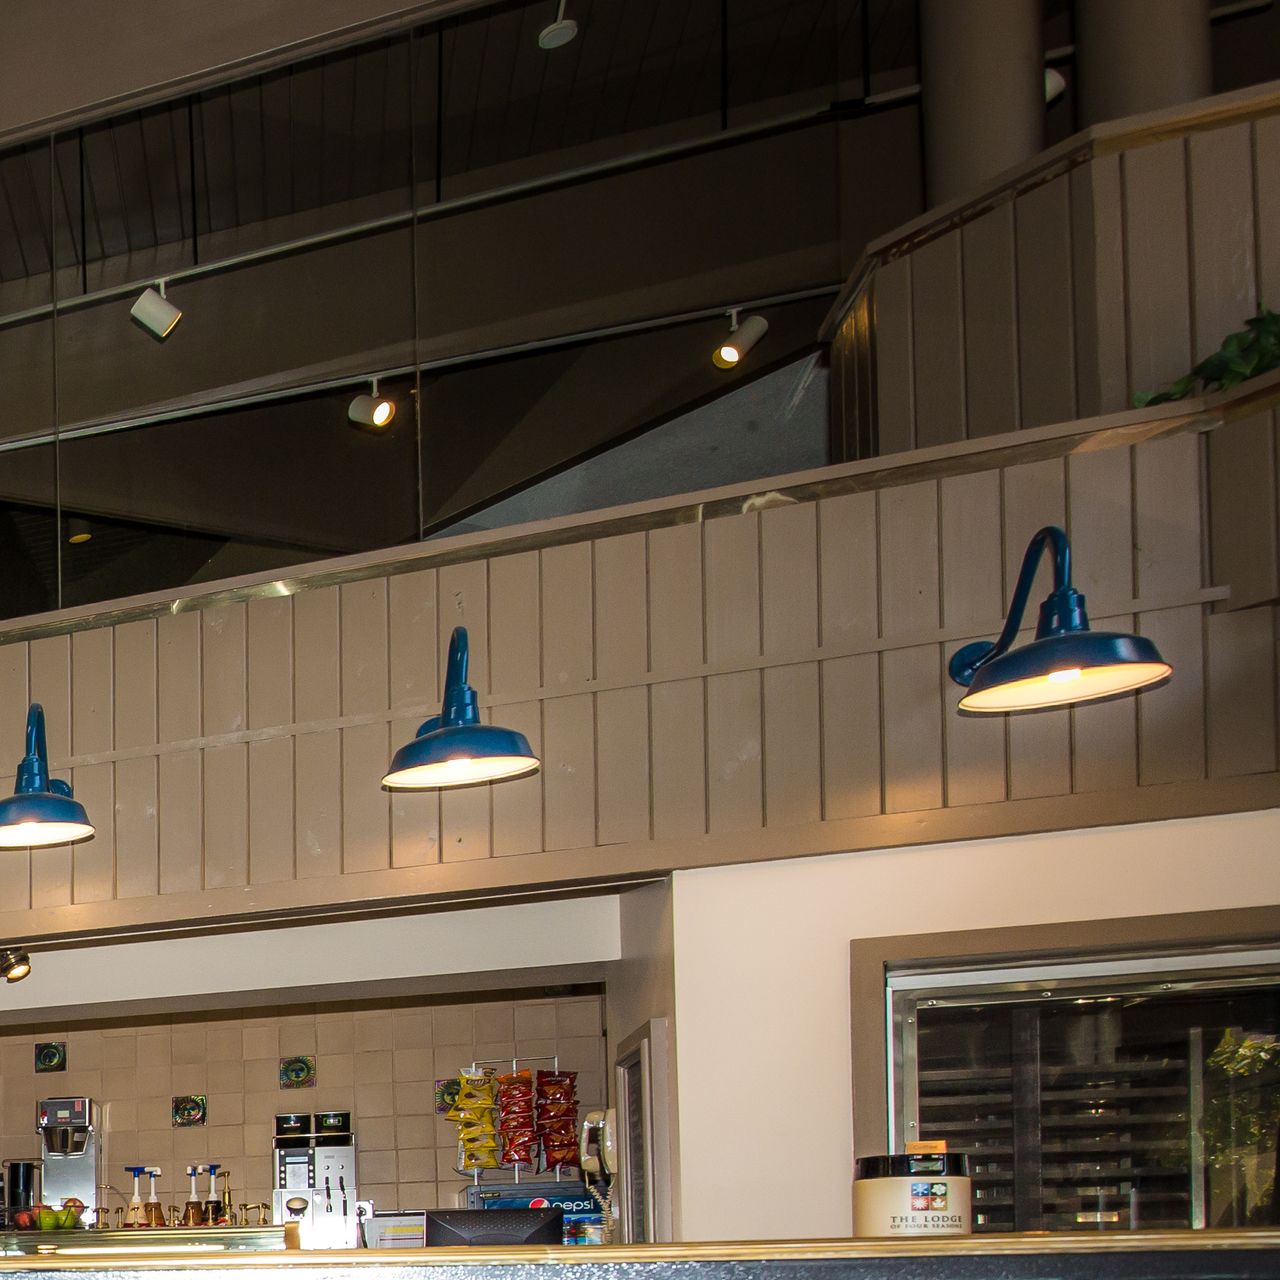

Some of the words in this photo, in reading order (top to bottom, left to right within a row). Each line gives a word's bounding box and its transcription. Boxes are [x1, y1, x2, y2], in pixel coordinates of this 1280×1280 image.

[552, 1199, 594, 1212] pepsi
[890, 1215, 917, 1223] THE
[924, 1215, 962, 1223] LODGE
